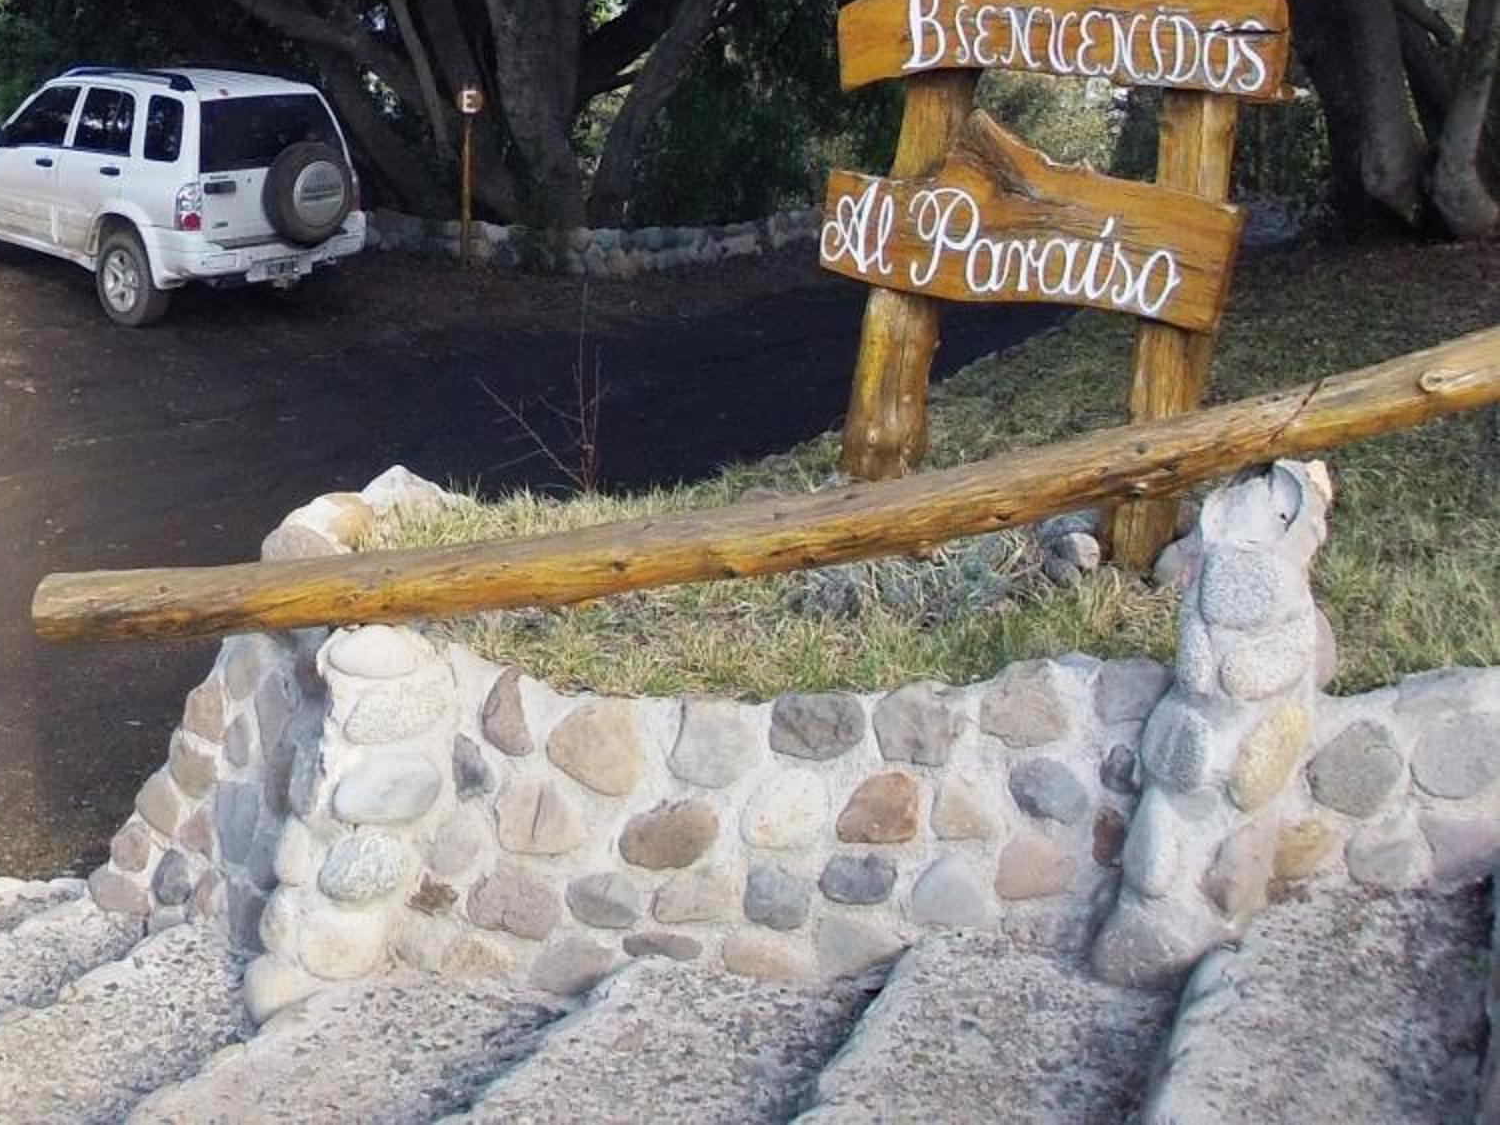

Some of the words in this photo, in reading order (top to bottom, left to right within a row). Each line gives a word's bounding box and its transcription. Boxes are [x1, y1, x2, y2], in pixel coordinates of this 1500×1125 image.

[462, 90, 477, 113] E
[820, 182, 894, 275] Al
[909, 187, 1180, 315] Paraíso
